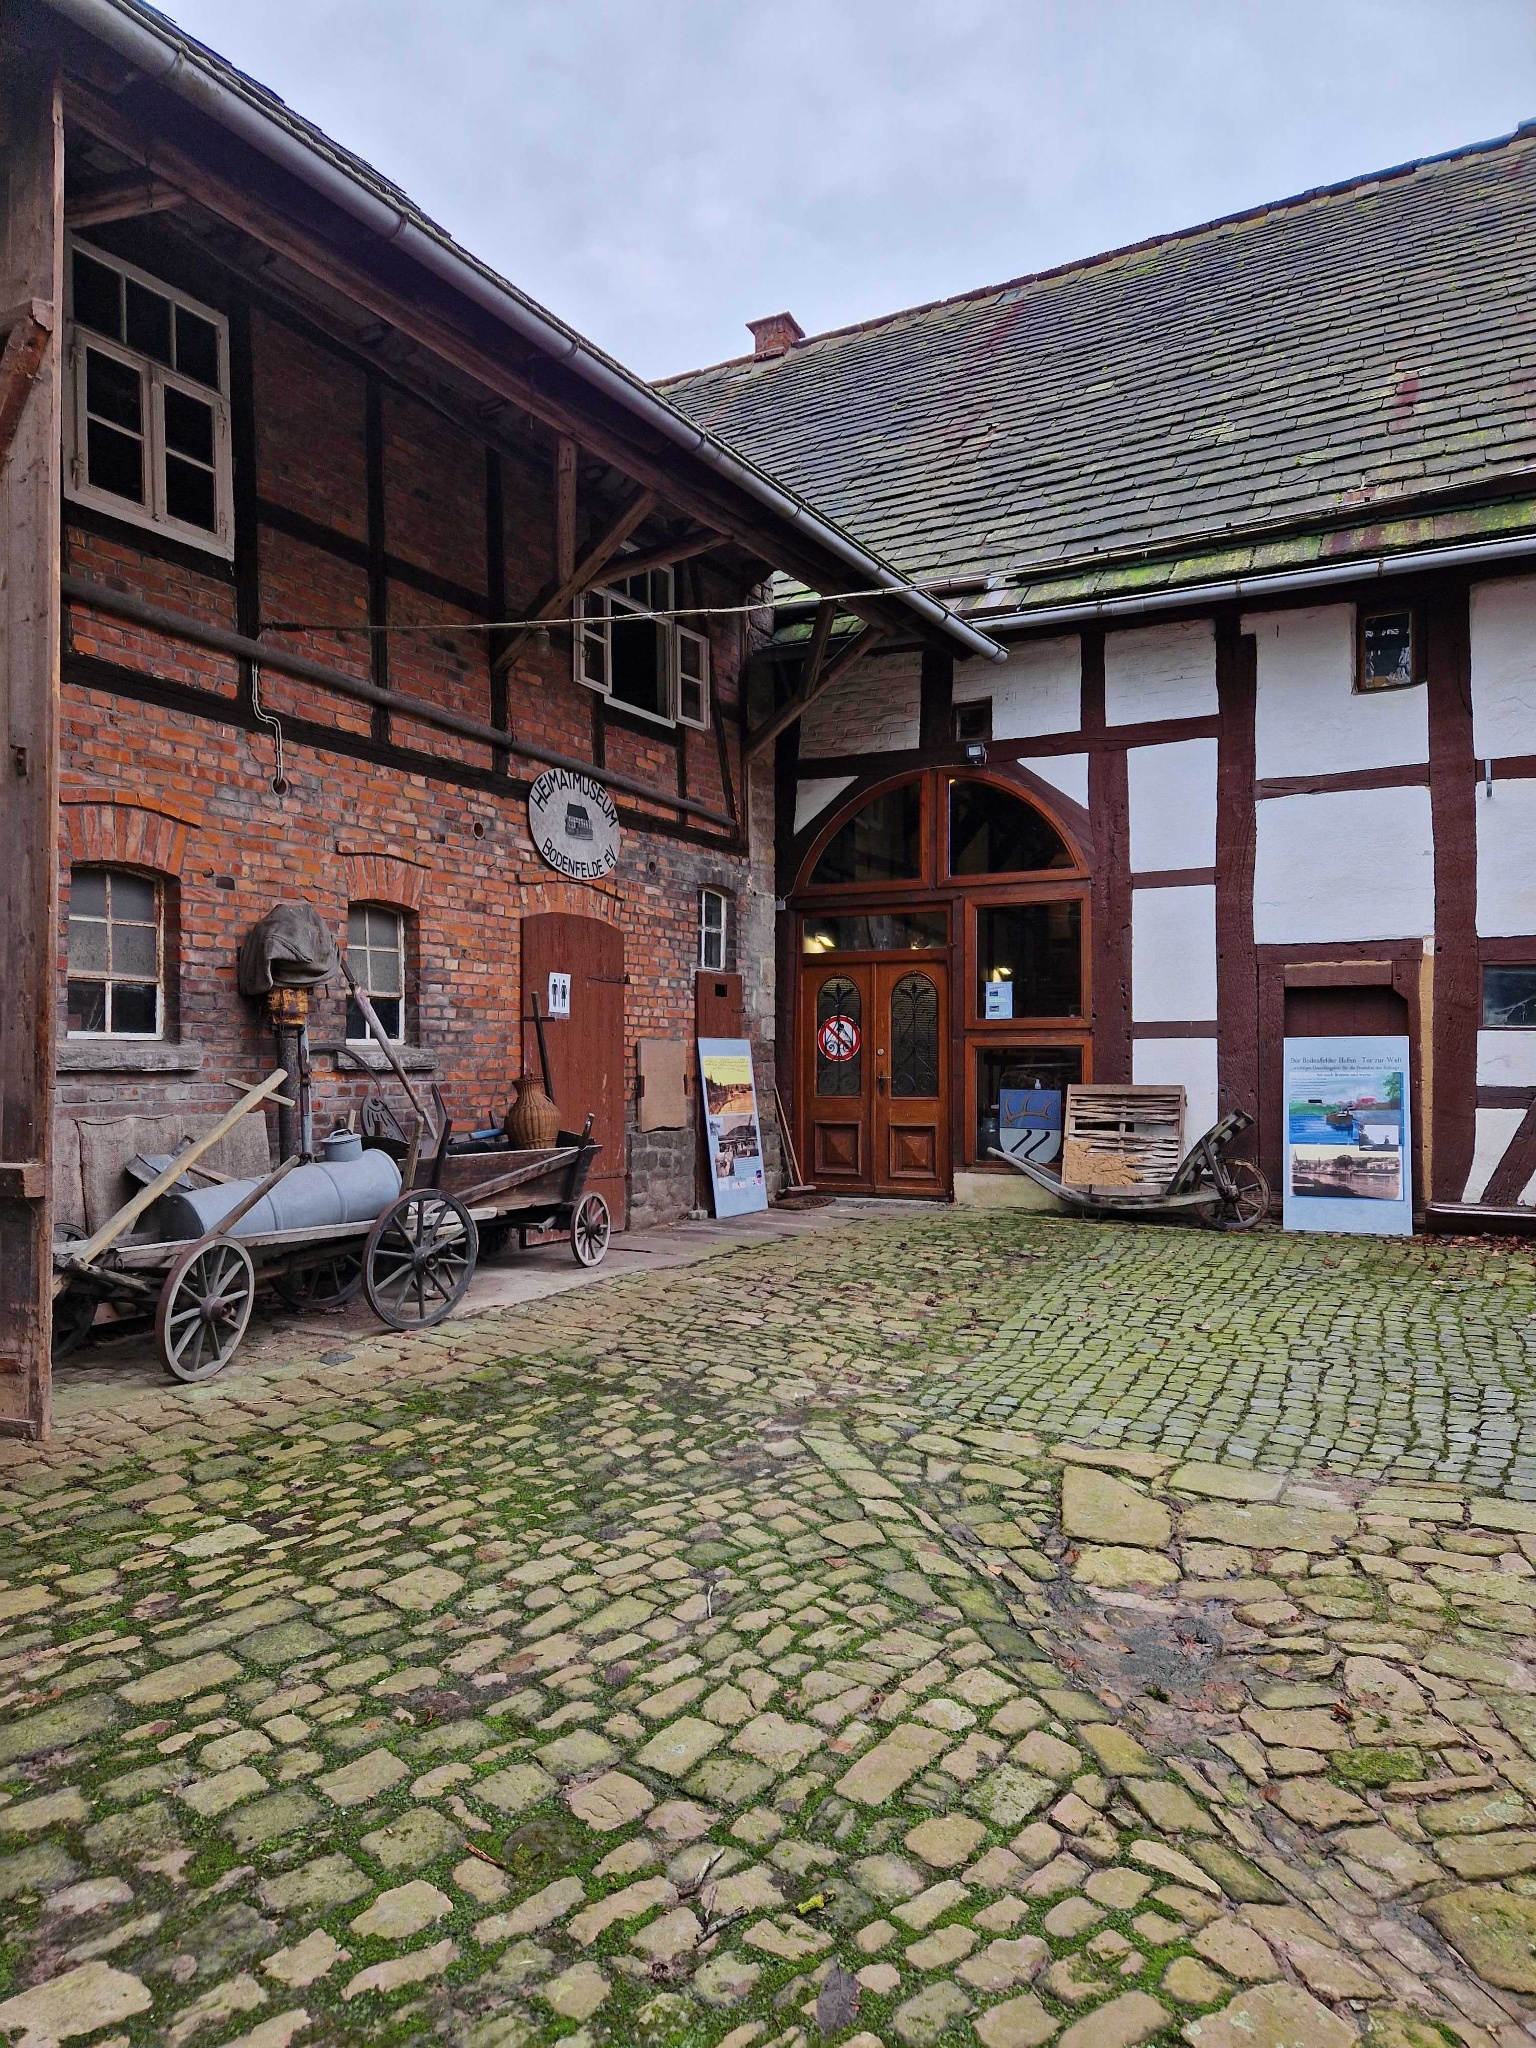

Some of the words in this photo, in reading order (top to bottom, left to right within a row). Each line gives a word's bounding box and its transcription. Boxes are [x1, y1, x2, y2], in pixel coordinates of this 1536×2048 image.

[530, 769, 618, 828] HEIMATMUSEUM
[542, 838, 604, 878] BODENFELDE
[604, 844, 616, 869] EV
[1302, 1056, 1336, 1064] Bodenfelder
[1338, 1056, 1357, 1064] Hafen
[1361, 1056, 1373, 1064] Tor
[1386, 1056, 1403, 1064] Welt
